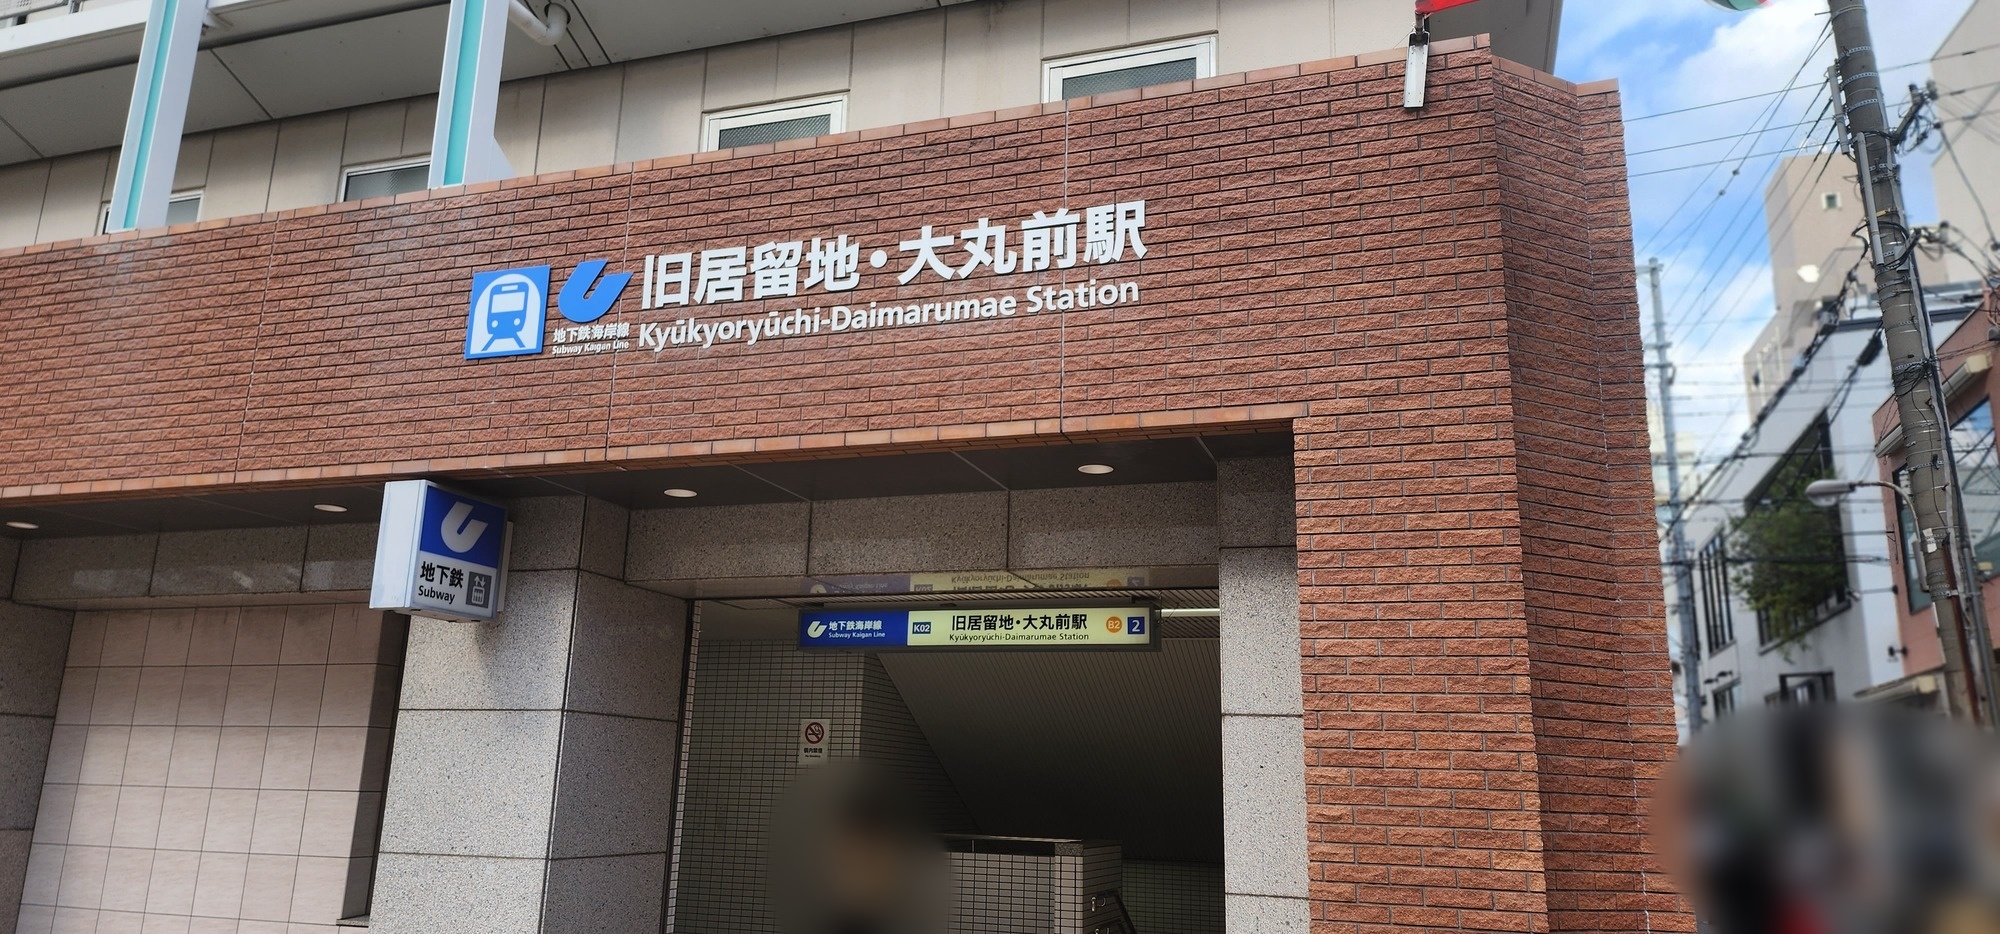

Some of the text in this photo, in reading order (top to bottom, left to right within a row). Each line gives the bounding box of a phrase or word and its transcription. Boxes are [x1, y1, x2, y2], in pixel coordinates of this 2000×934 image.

[640, 199, 1148, 310] 旧居留地・大丸前駅
[638, 279, 1139, 353] Kyūkyoryūchi-Daimarumae Station
[552, 321, 631, 343] 地下鉄海岸線
[551, 338, 630, 355] Subway Kaigan Line
[420, 561, 464, 589] 地下鉄
[418, 585, 456, 605] Subway
[828, 620, 882, 631] 地下鉄海岸線
[913, 623, 931, 633] K02
[952, 613, 1088, 631] 旧居留地・大丸前駅
[1107, 620, 1120, 630] B2
[1131, 619, 1141, 632] 2
[828, 630, 886, 639] Subway Kaigan Line
[1059, 632, 1089, 641] Station
